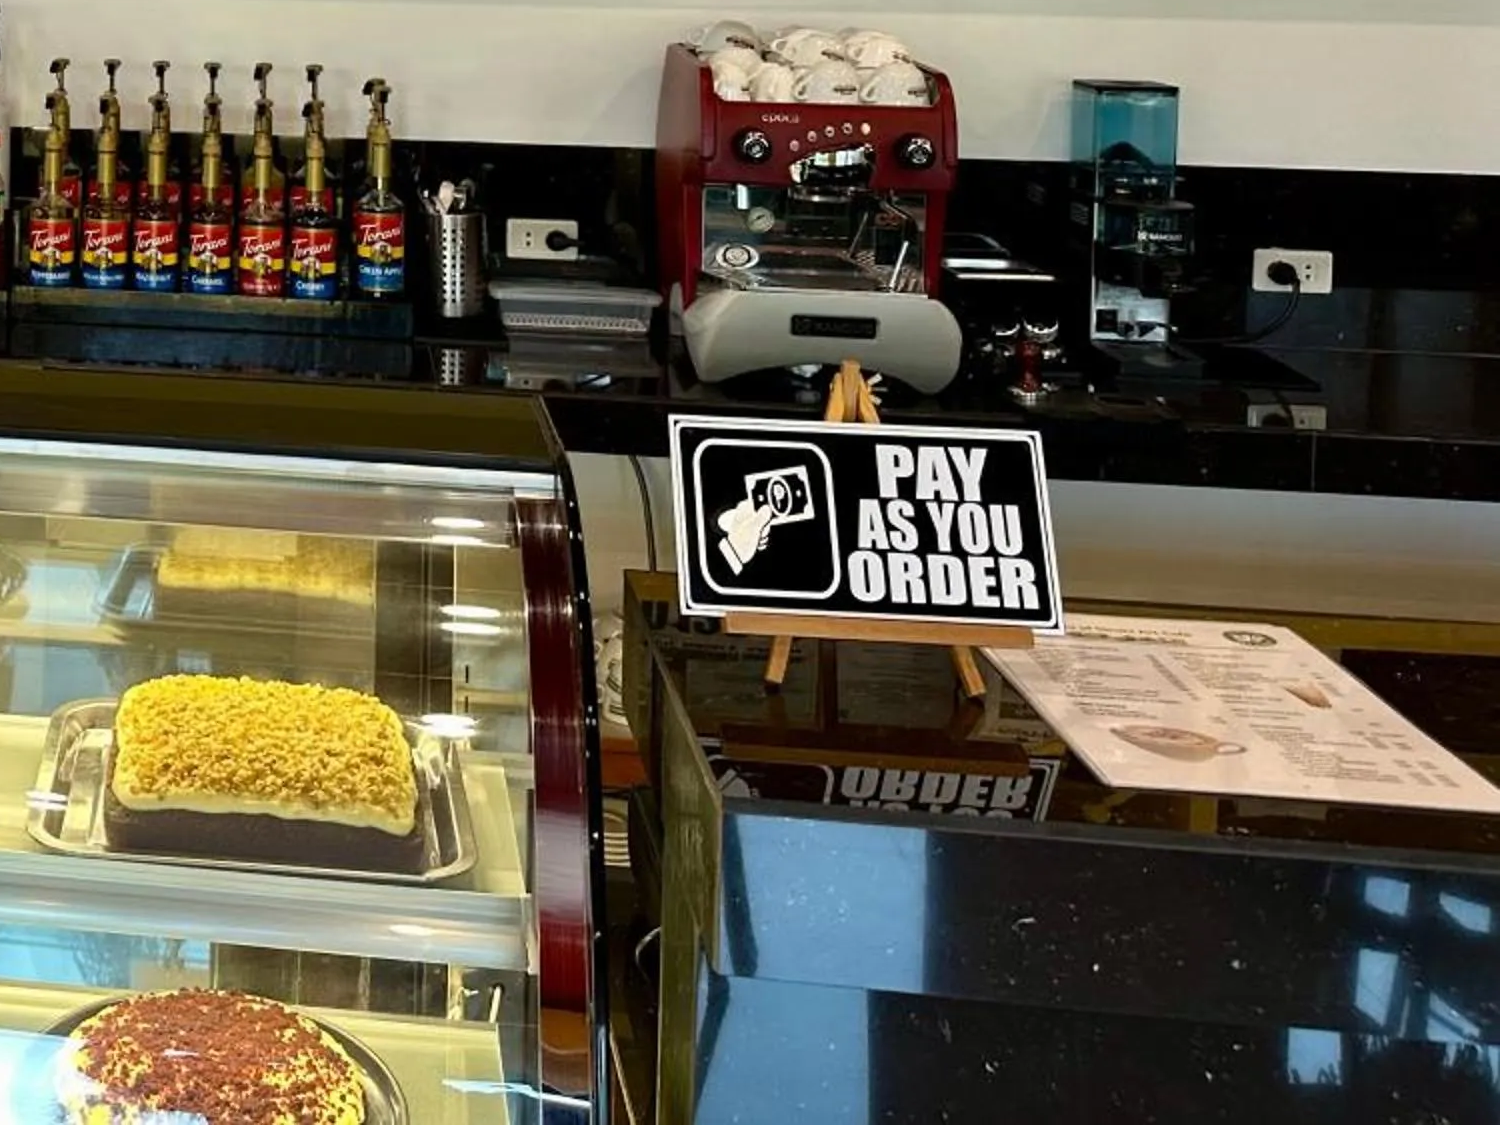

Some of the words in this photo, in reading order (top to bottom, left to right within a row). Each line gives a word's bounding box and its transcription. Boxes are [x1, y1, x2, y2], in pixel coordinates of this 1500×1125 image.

[31, 227, 70, 249] Torani
[84, 229, 123, 250] Torani
[134, 229, 173, 251] Torani
[190, 234, 228, 254] Torani
[360, 224, 401, 244] Torani
[241, 235, 282, 256] Torani
[292, 238, 332, 258] Torani
[874, 444, 988, 502] PAY
[858, 498, 919, 551] AS
[925, 501, 1024, 556] YOU
[848, 550, 1040, 610] ORDER
